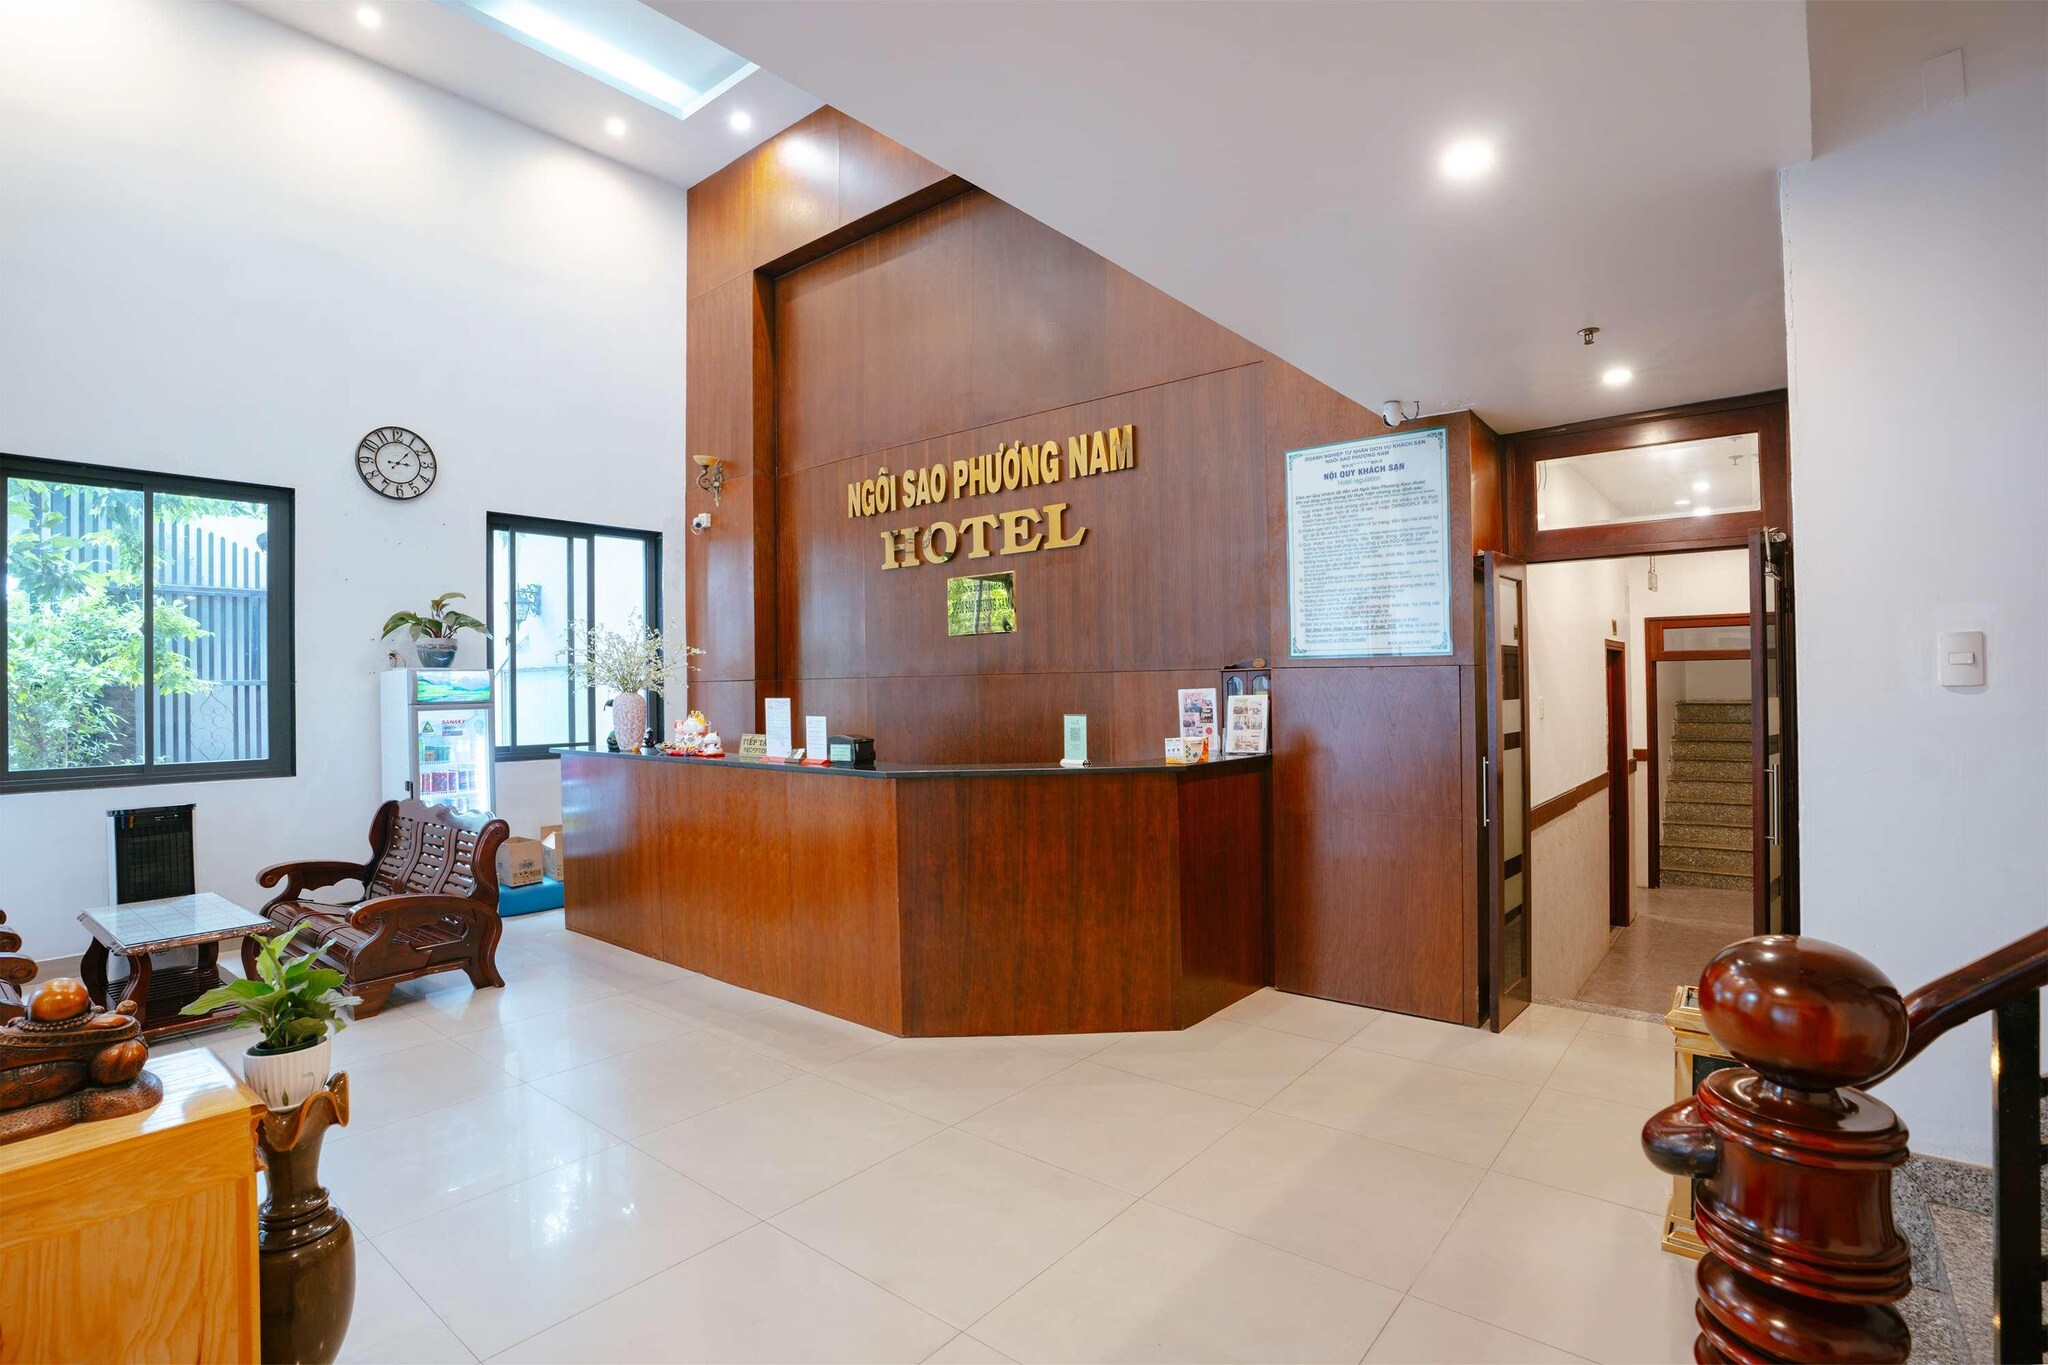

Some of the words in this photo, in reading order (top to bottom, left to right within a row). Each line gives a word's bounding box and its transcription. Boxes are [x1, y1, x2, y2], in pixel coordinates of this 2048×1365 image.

[374, 431, 388, 444] 11
[392, 428, 403, 443] 12
[409, 434, 417, 447] 1
[362, 439, 379, 452] 10
[416, 447, 430, 456] 2
[365, 470, 379, 480] 8
[848, 466, 896, 518] NGÔI
[902, 464, 947, 508] SAO
[954, 440, 1062, 499] PHƯƠNG
[1068, 424, 1136, 479] NAM
[1324, 471, 1337, 481] NỘI
[1340, 468, 1355, 479] QUY
[1358, 464, 1385, 476] KHÁCH
[1388, 462, 1404, 472] SẠN
[420, 474, 432, 483] 4
[1353, 475, 1380, 484] regulation
[381, 479, 390, 493] 7
[396, 484, 403, 498] 6
[408, 482, 420, 496] 5
[881, 503, 1088, 570] HOTEL
